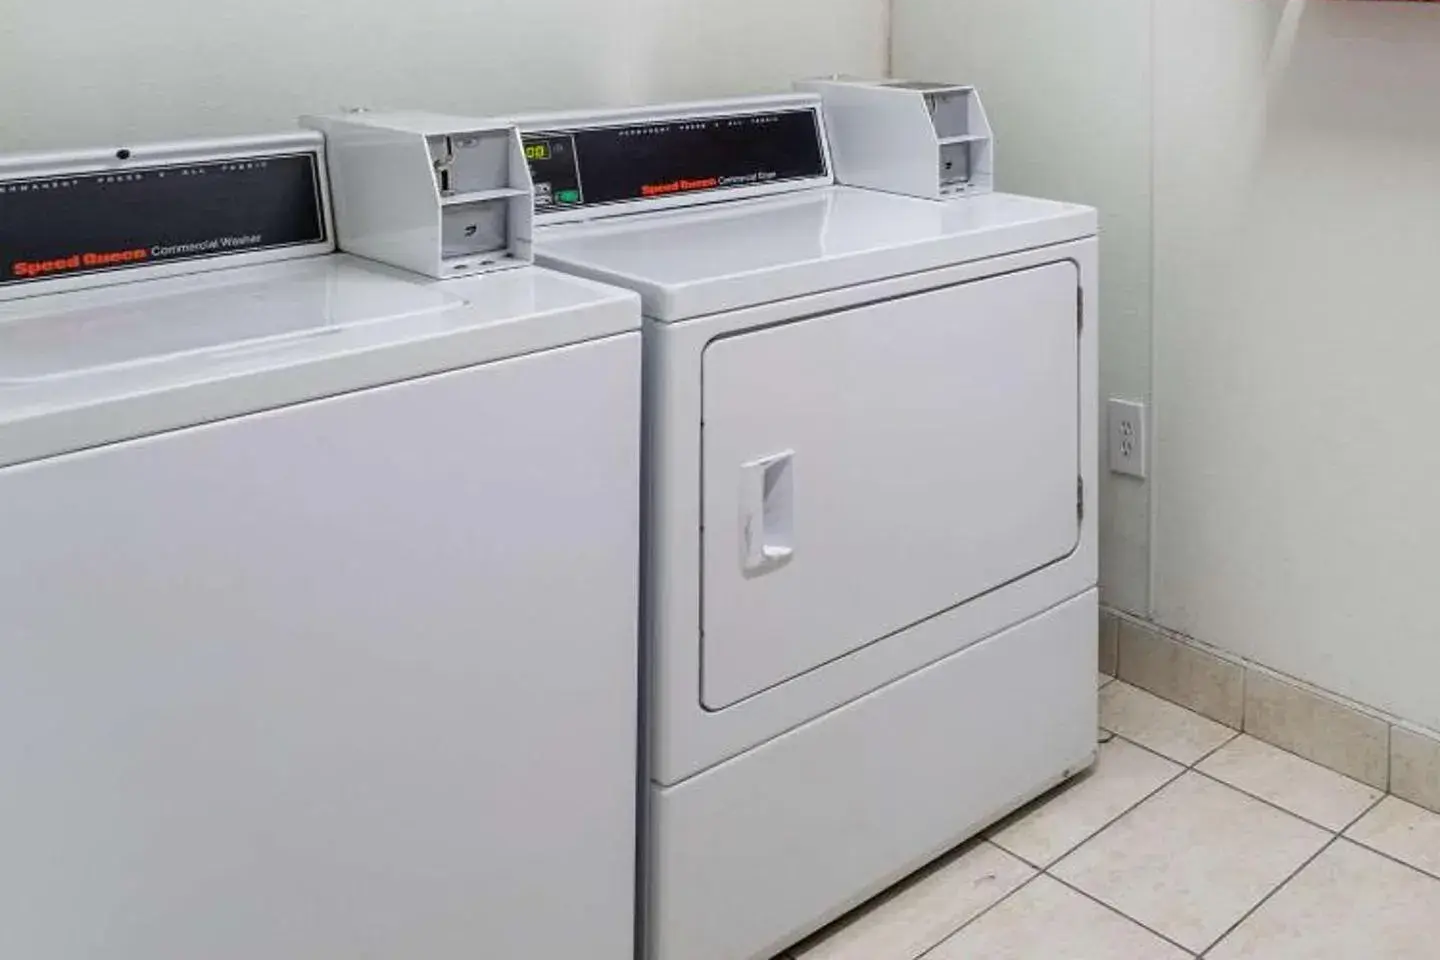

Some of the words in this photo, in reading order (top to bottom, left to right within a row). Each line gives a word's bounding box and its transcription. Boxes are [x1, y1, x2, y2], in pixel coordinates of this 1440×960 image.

[13, 254, 80, 276] Speed
[82, 246, 147, 266] Queen
[151, 238, 219, 257] Commercial
[219, 233, 262, 250] Washer
